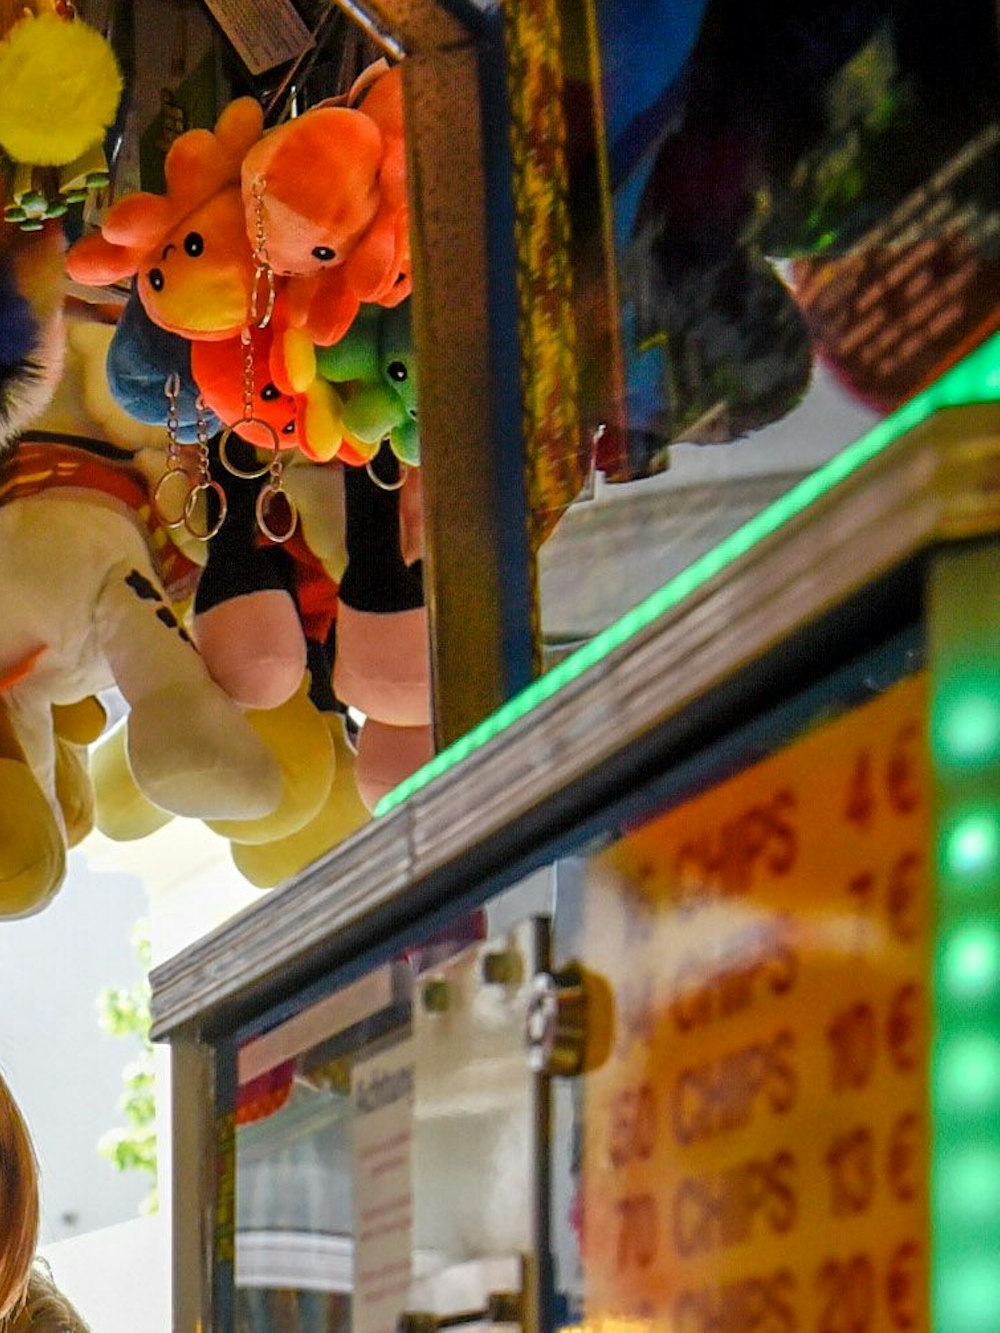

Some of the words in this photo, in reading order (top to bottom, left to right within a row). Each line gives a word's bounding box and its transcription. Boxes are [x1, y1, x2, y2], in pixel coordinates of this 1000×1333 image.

[886, 722, 918, 818] €
[886, 848, 918, 945] €
[672, 1025, 797, 1148] CHIPS
[886, 978, 918, 1075] €
[672, 1149, 797, 1260] CHIPS
[886, 1108, 918, 1204] €
[884, 1237, 918, 1333] €
